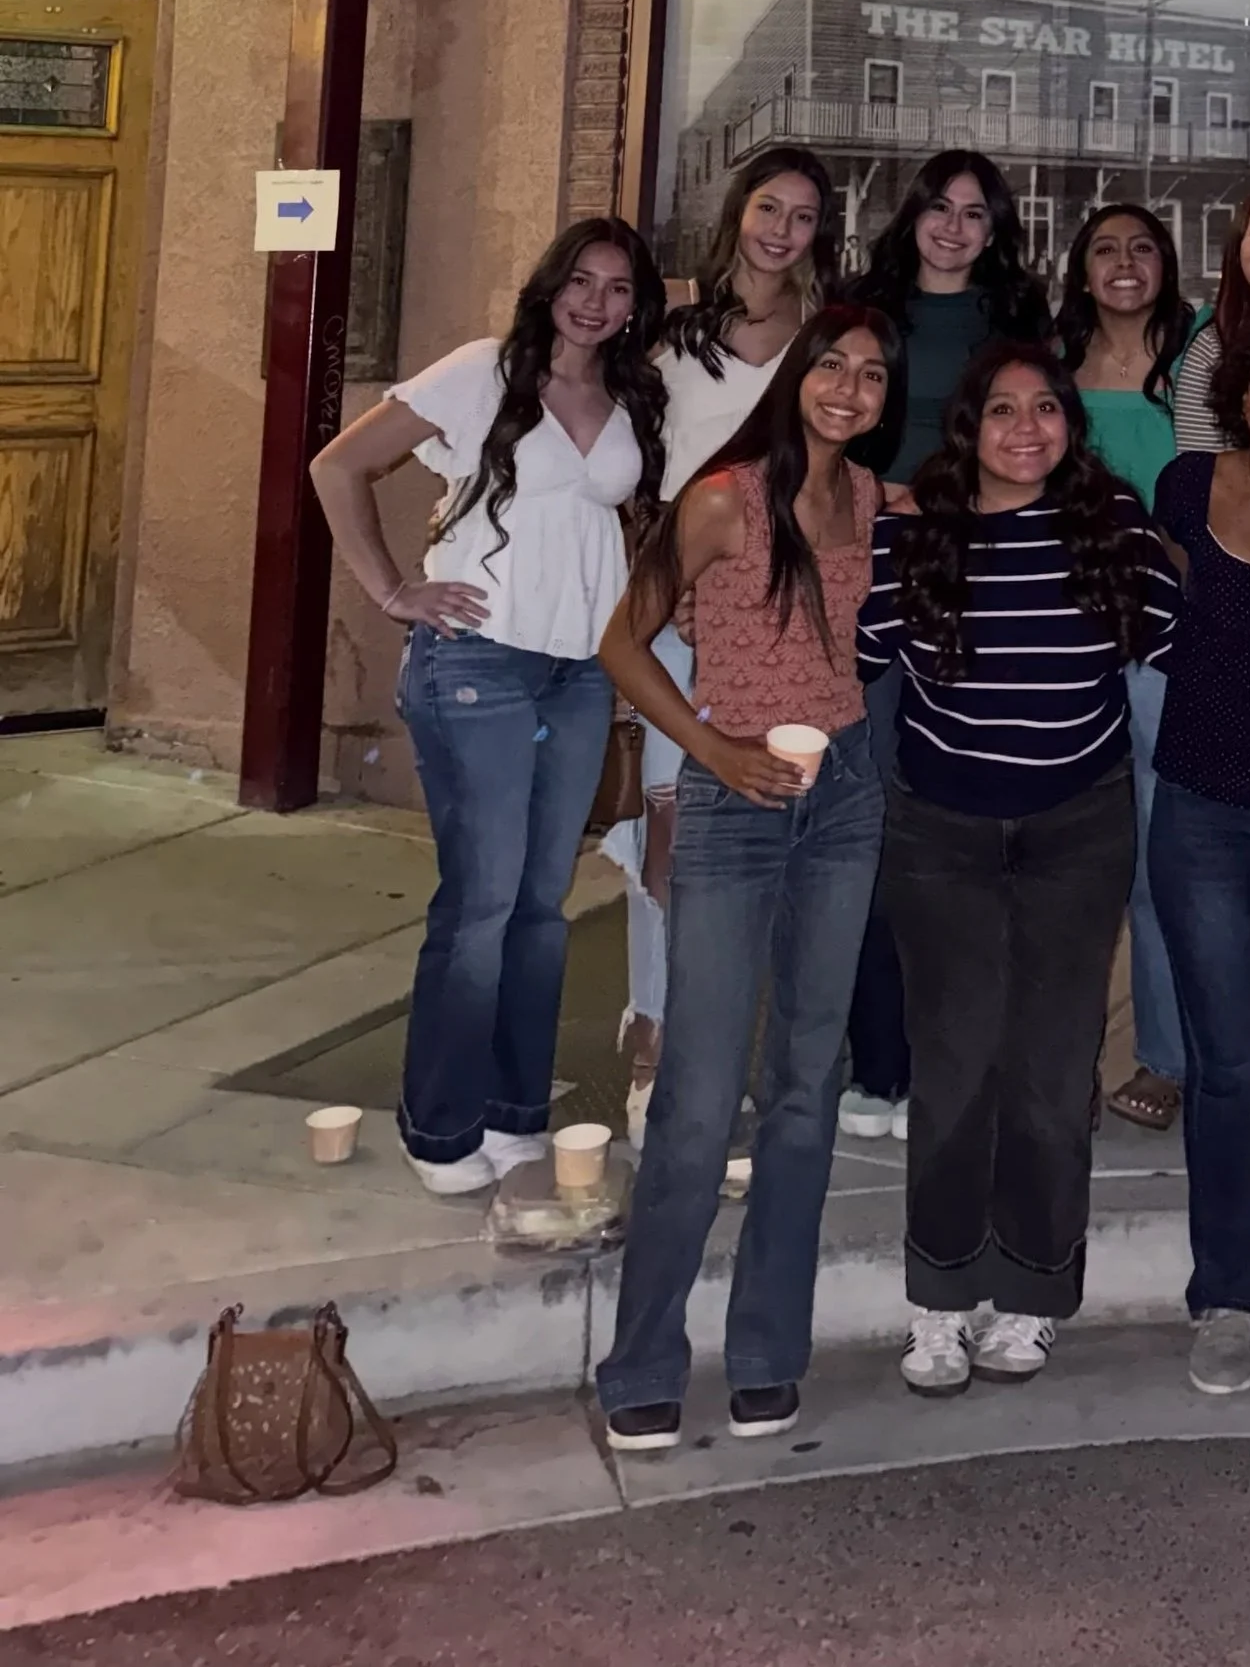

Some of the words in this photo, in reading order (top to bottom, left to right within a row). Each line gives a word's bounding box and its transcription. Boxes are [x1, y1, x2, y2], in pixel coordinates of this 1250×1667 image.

[861, 2, 959, 43] THE
[978, 16, 1092, 58] STAR
[1108, 33, 1235, 74] HOTEL
